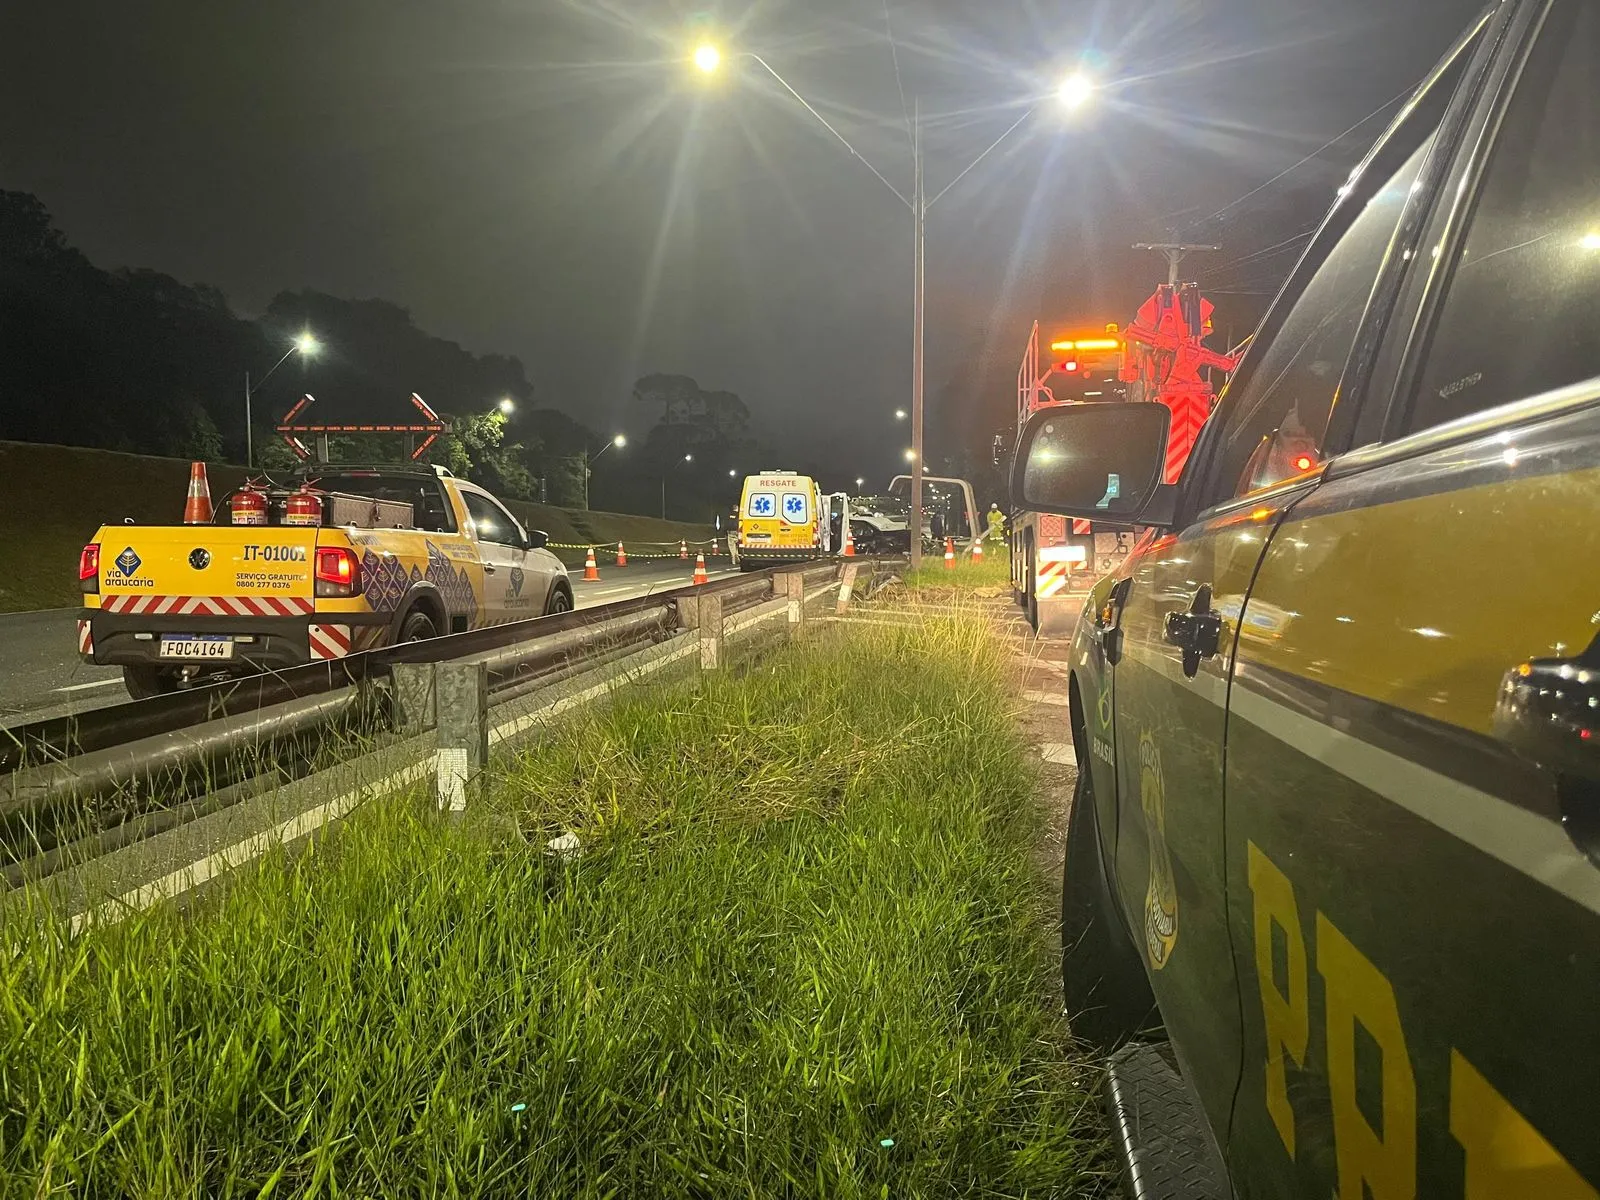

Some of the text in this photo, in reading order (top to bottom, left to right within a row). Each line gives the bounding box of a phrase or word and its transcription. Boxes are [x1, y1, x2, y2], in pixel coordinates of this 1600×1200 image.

[243, 545, 307, 562] IT-01001
[106, 567, 122, 578] via
[236, 573, 267, 581] SERVIÇO
[105, 576, 154, 587] araucária
[256, 581, 271, 589] 277
[166, 642, 225, 656] FQC4I64
[1093, 735, 1114, 768] BRASIL
